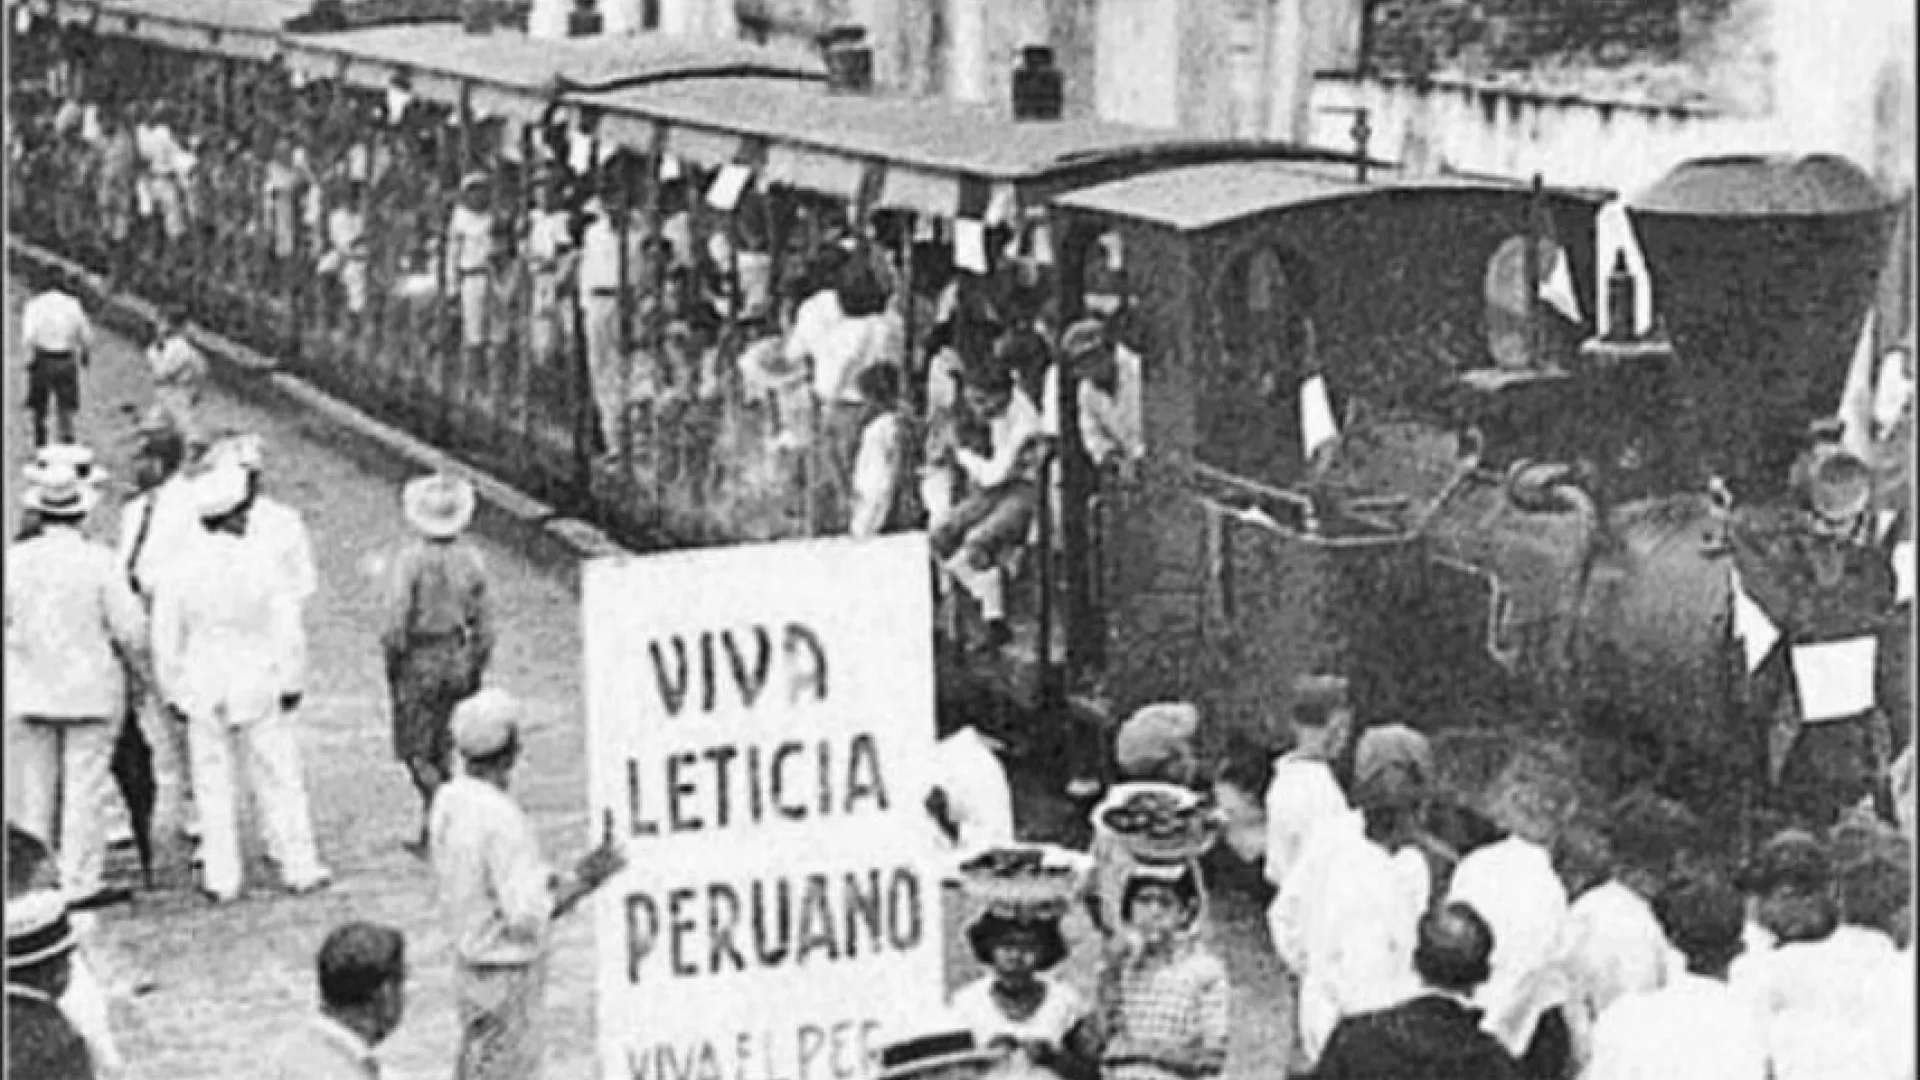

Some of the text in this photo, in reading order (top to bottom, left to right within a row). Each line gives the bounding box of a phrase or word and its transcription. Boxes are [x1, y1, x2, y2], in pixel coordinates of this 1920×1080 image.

[649, 622, 828, 715] VIVA
[627, 733, 888, 836] LETICIA
[626, 868, 922, 982] PERUANO
[626, 1041, 721, 1080] VIVA
